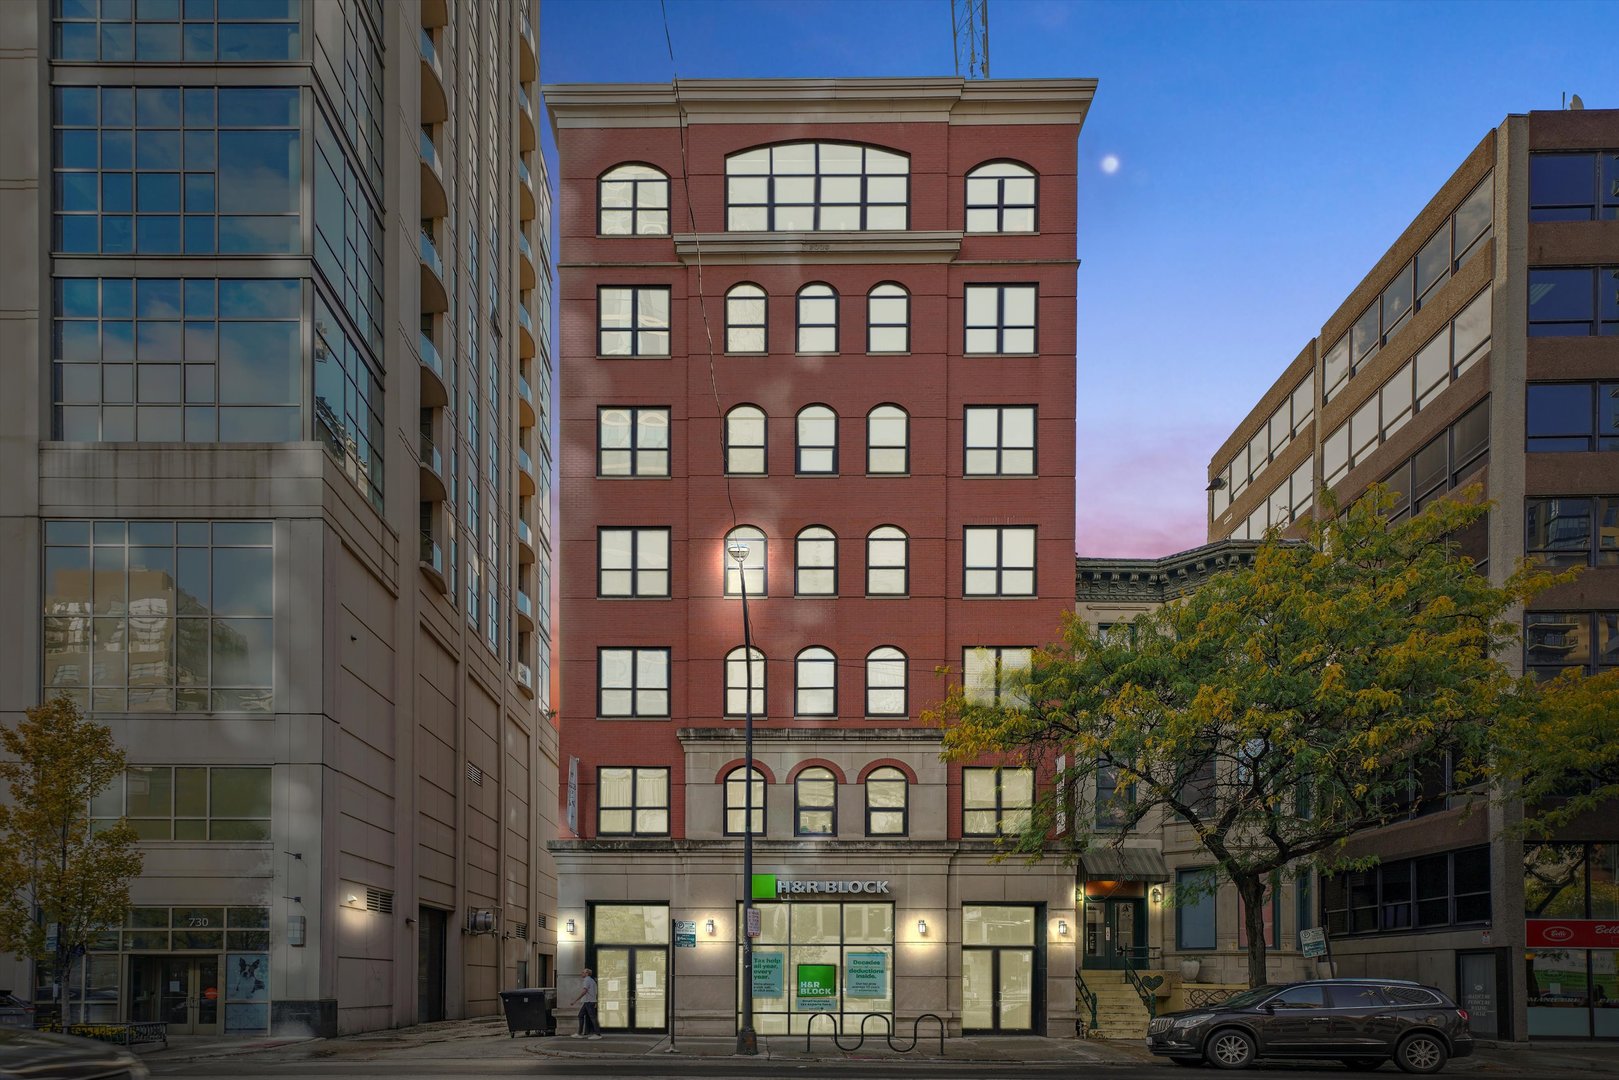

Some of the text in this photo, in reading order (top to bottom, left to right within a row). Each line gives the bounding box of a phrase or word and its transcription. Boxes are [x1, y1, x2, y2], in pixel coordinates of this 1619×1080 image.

[777, 880, 889, 894] H&R BLOCK
[189, 918, 208, 926] 730
